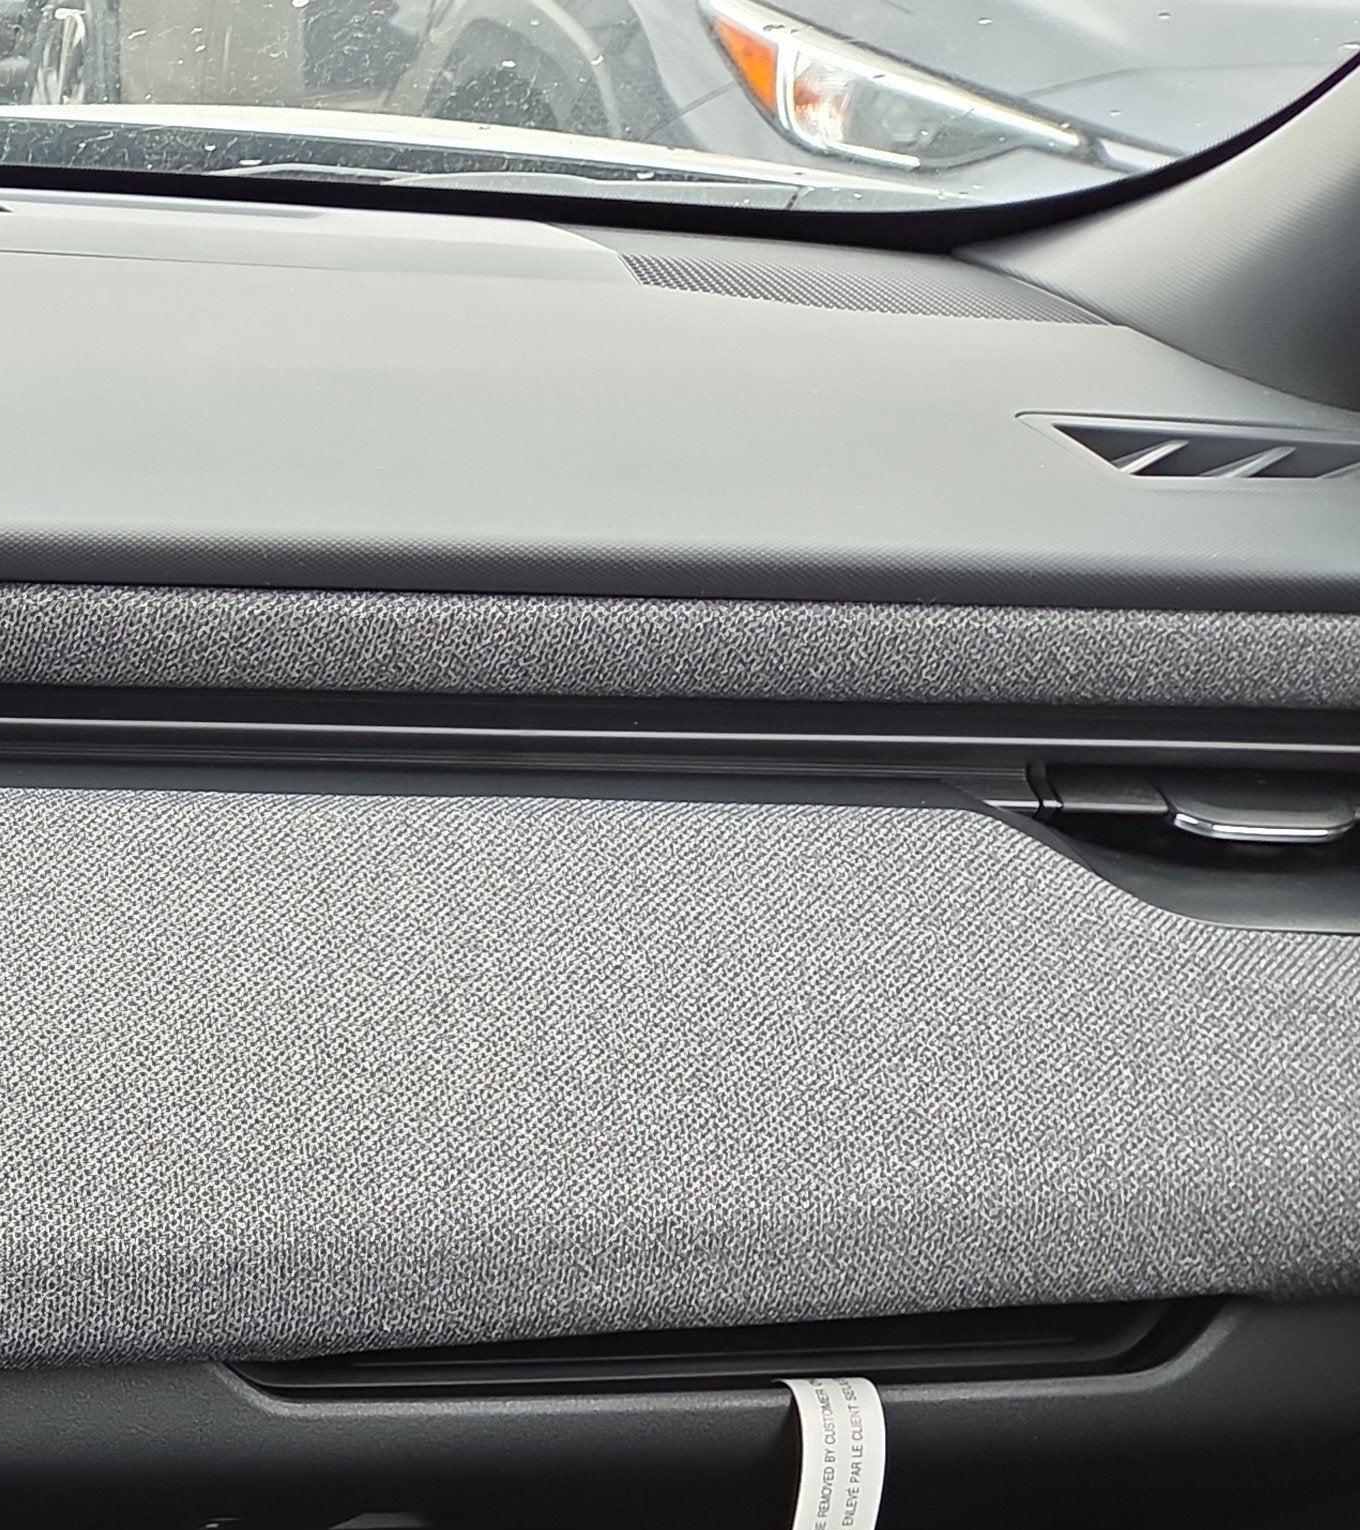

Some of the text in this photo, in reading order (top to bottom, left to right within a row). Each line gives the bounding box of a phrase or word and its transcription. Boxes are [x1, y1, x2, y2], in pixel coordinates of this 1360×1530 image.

[824, 1448, 836, 1463] BY
[852, 1445, 863, 1458] LE
[849, 1461, 862, 1484] PAR
[817, 1466, 835, 1518] REMOVED
